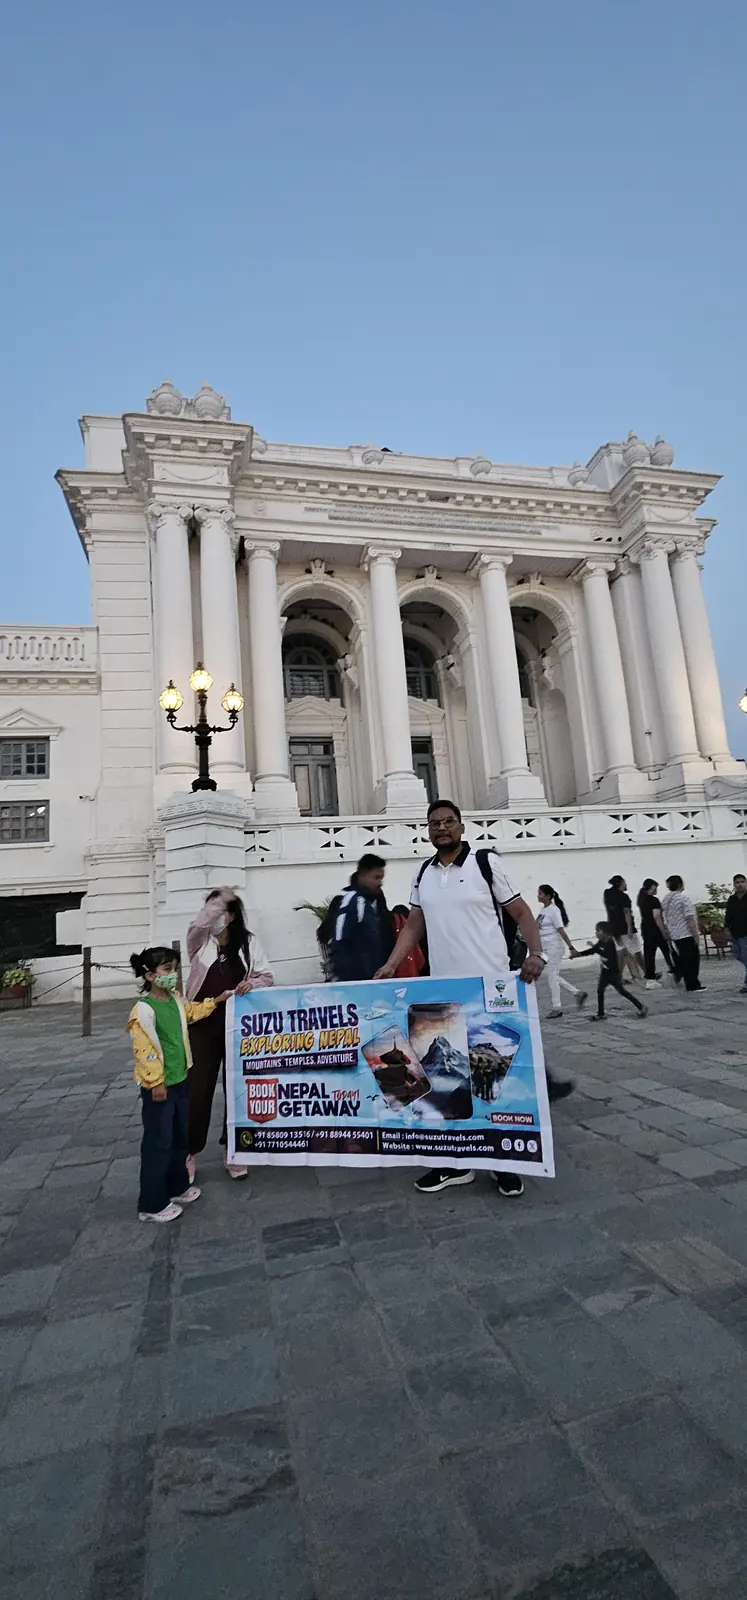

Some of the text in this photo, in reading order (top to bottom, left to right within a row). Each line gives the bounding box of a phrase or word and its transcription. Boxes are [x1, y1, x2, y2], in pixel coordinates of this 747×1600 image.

[241, 1004, 359, 1037] SUZU TRAVELS
[240, 1028, 360, 1056] EXPLORING NEPAL
[246, 1054, 356, 1070] MOUNTAINS. TEMPLES. ADVENTURE.
[249, 1084, 276, 1098] BOOK
[278, 1083, 330, 1100] NEPAL
[332, 1089, 360, 1101] TODAY!
[249, 1100, 275, 1115] YOUR
[278, 1101, 360, 1117] GETAWAY
[492, 1114, 533, 1123] BOOK NOW
[254, 1131, 265, 1139] +91
[382, 1132, 401, 1140] Email
[405, 1132, 484, 1141] info@suzutravels.com
[382, 1142, 410, 1150] Website
[415, 1144, 494, 1152] www.suzutravels.com
